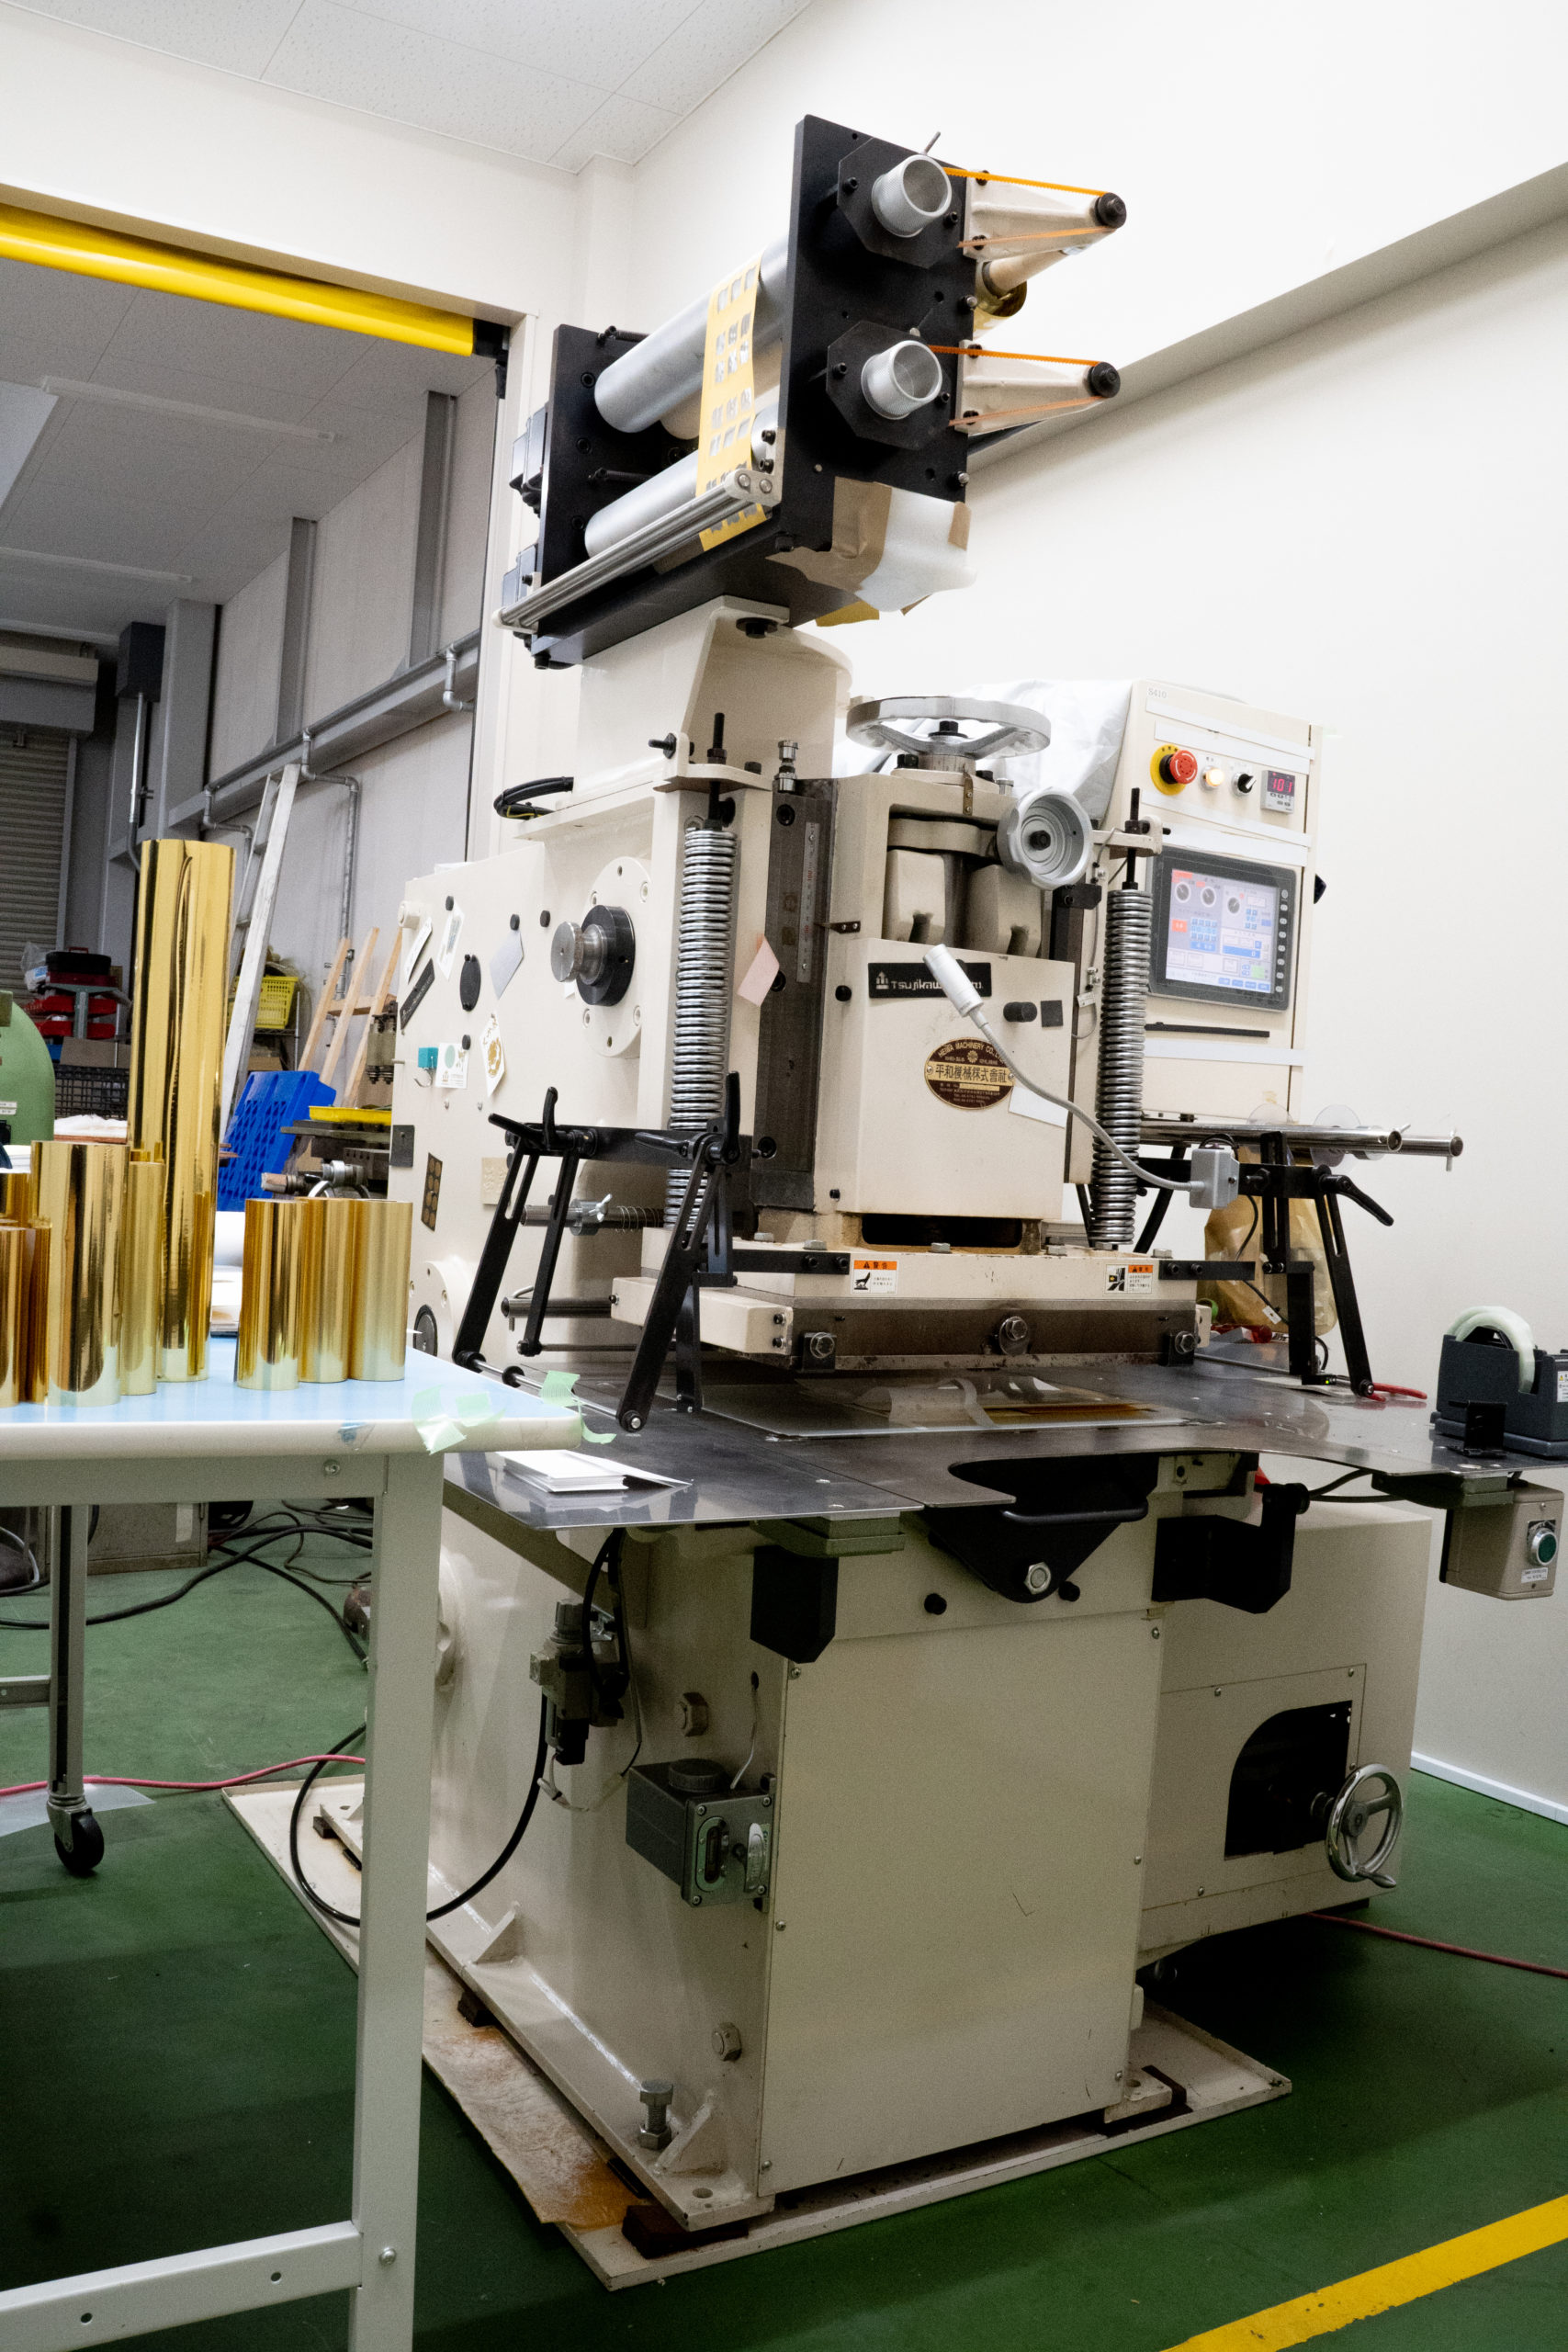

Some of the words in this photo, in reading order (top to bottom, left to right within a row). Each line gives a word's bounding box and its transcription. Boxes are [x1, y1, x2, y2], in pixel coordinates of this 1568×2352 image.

[1272, 778, 1292, 793] 101
[890, 978, 943, 990] Tsujikaw
[955, 1041, 985, 1051] MACHINERY
